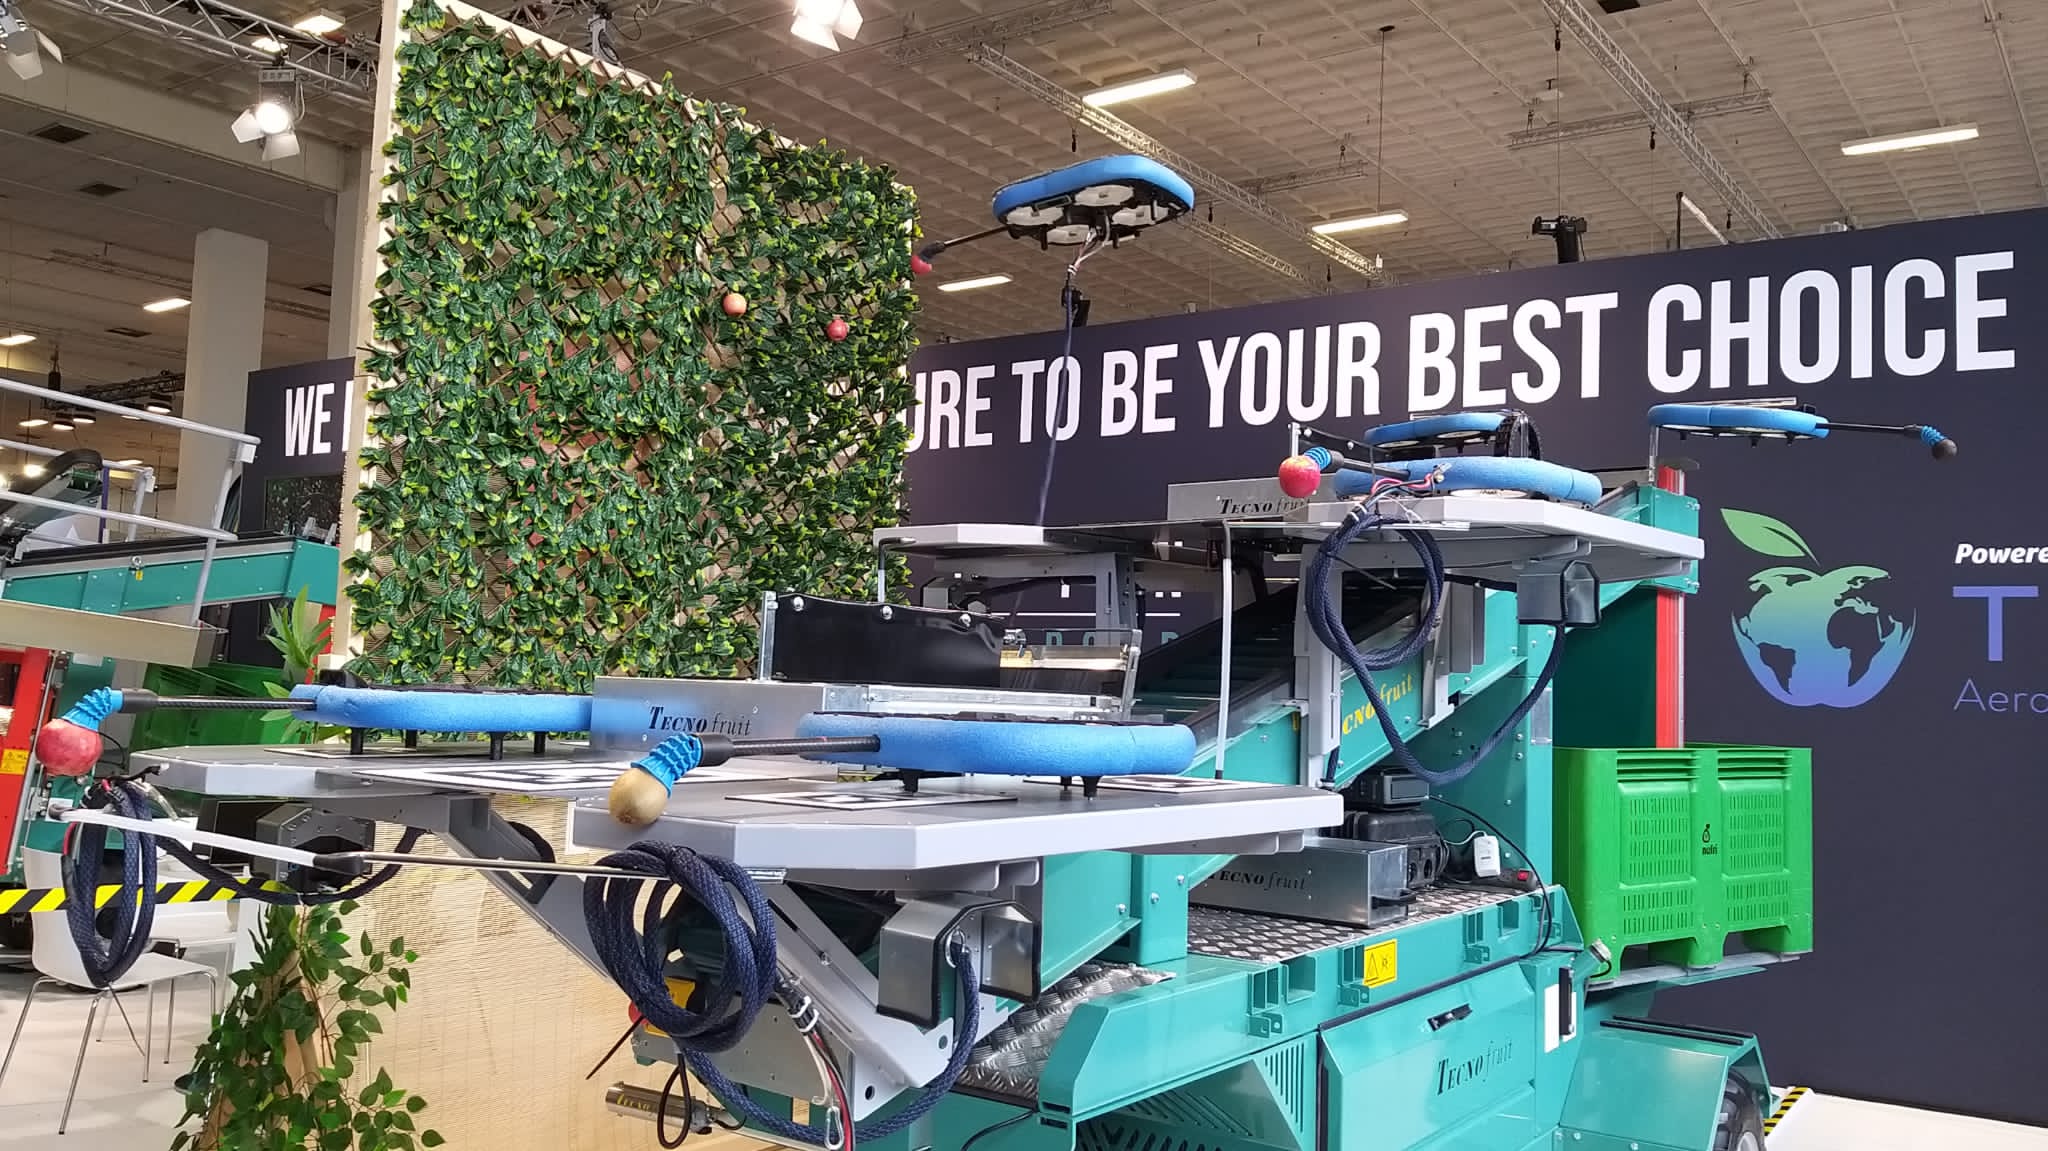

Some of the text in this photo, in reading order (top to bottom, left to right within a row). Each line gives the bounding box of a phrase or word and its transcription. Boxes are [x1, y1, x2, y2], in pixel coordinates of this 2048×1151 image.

[285, 382, 335, 457] WE
[1011, 356, 1081, 443] TO
[1100, 344, 1178, 437] BE
[1198, 321, 1381, 428] YOUR
[1408, 292, 1618, 412] BEST
[1647, 251, 2015, 393] CHOICE
[711, 711, 751, 736] fruit
[1208, 870, 1265, 886] ECNO
